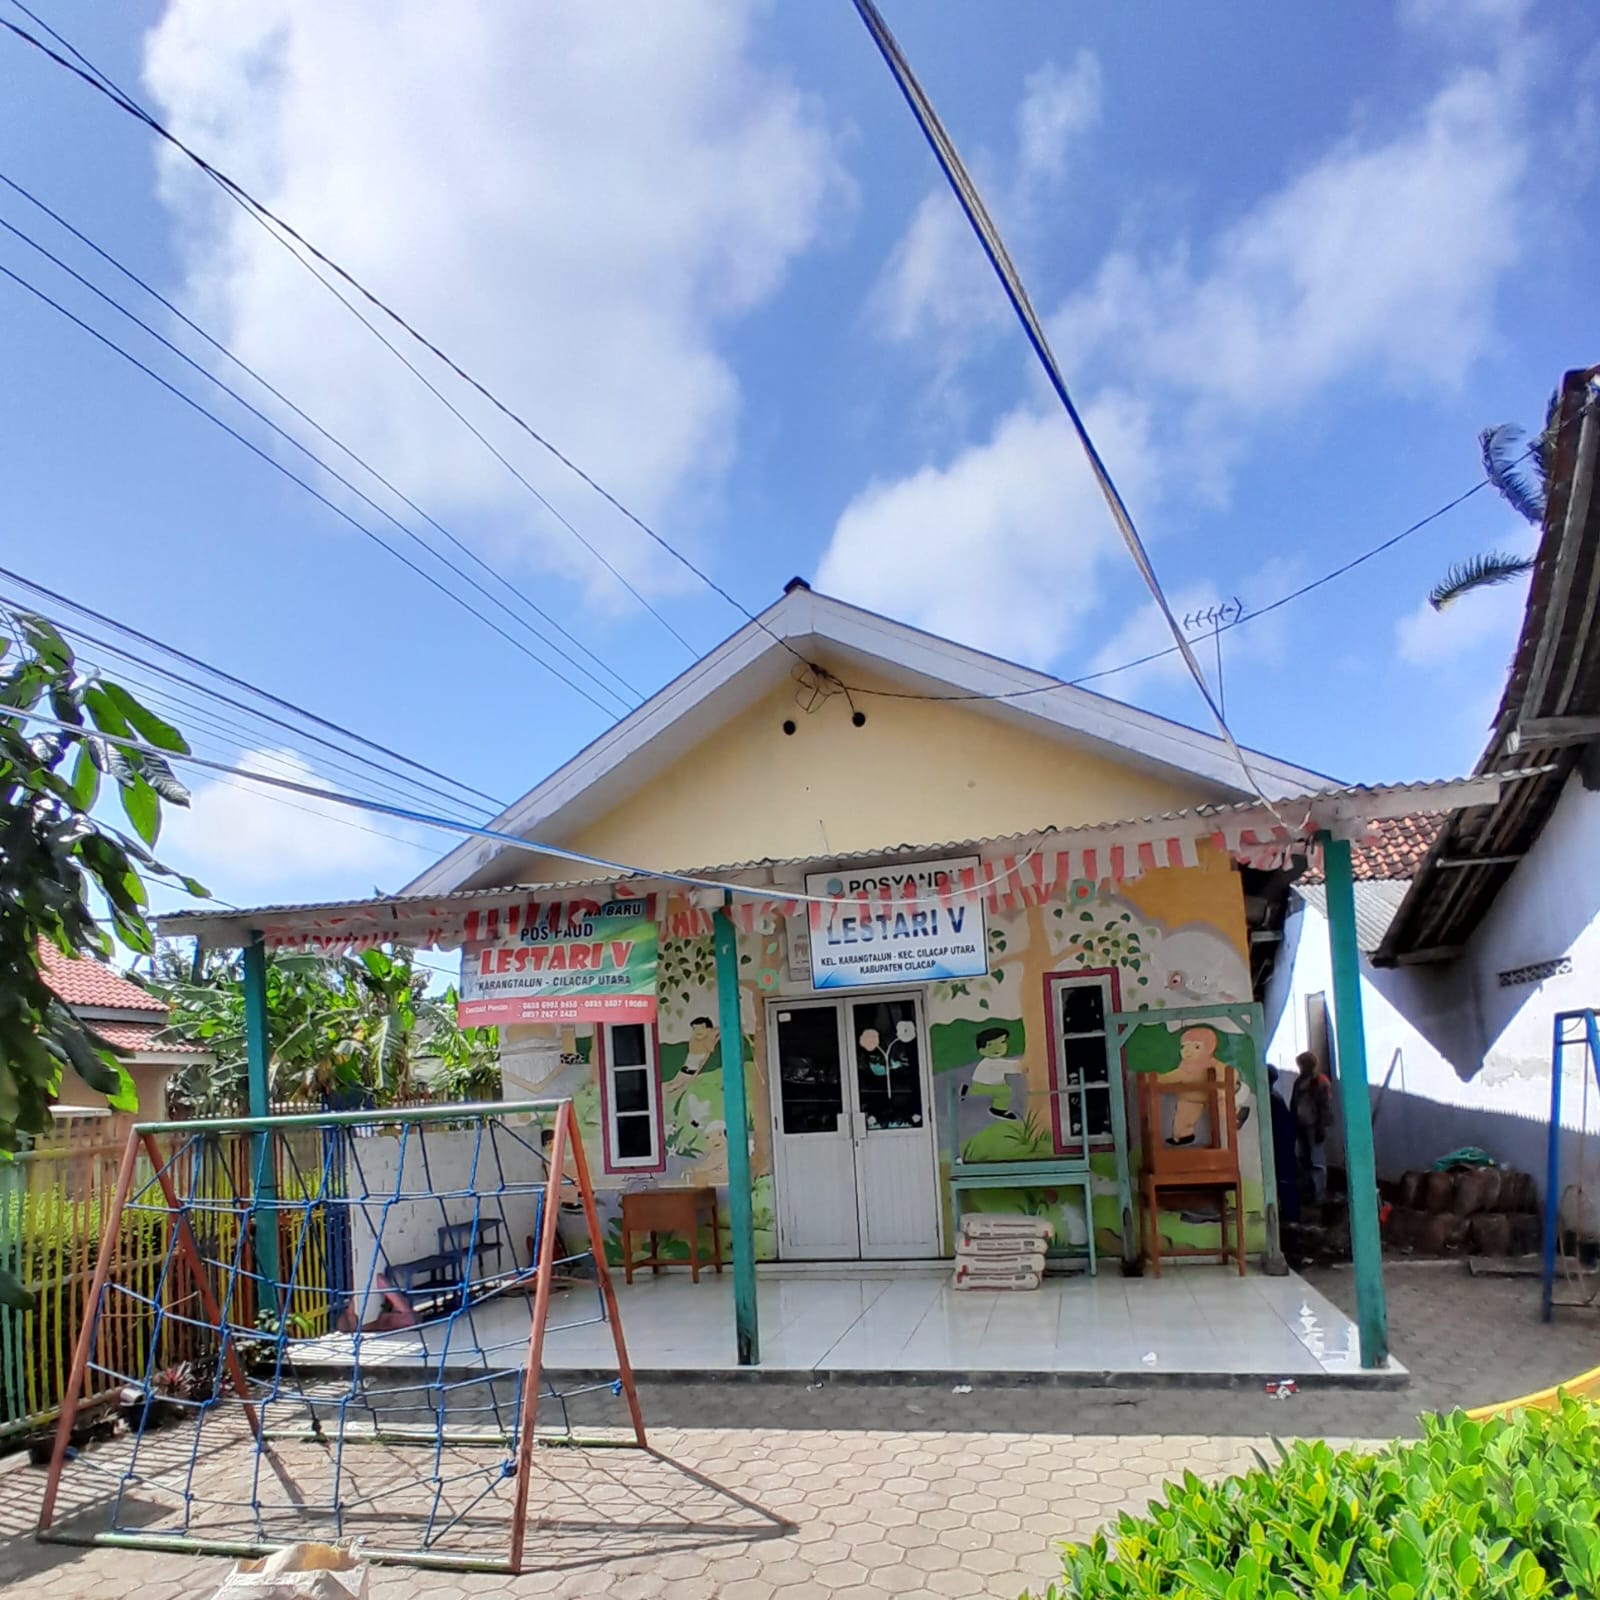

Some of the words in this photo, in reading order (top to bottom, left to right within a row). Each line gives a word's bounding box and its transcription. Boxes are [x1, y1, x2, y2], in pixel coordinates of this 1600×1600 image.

[606, 903, 641, 917] BARU
[520, 926, 549, 942] POS
[827, 909, 938, 946] LESTARI
[947, 906, 965, 933] V
[480, 942, 604, 976] LESTARI
[611, 941, 634, 969] V
[821, 957, 837, 966] KEL.
[839, 952, 893, 965] KARANGTALUN
[898, 950, 915, 960] KEC.
[917, 947, 948, 959] CILACAP
[950, 944, 976, 955] UTARA
[860, 963, 902, 975] KABUPATEN
[904, 960, 936, 972] CILACAP
[478, 977, 543, 991] KARANGTALUN
[553, 976, 595, 988] CILACAP
[598, 975, 632, 986] UTARA
